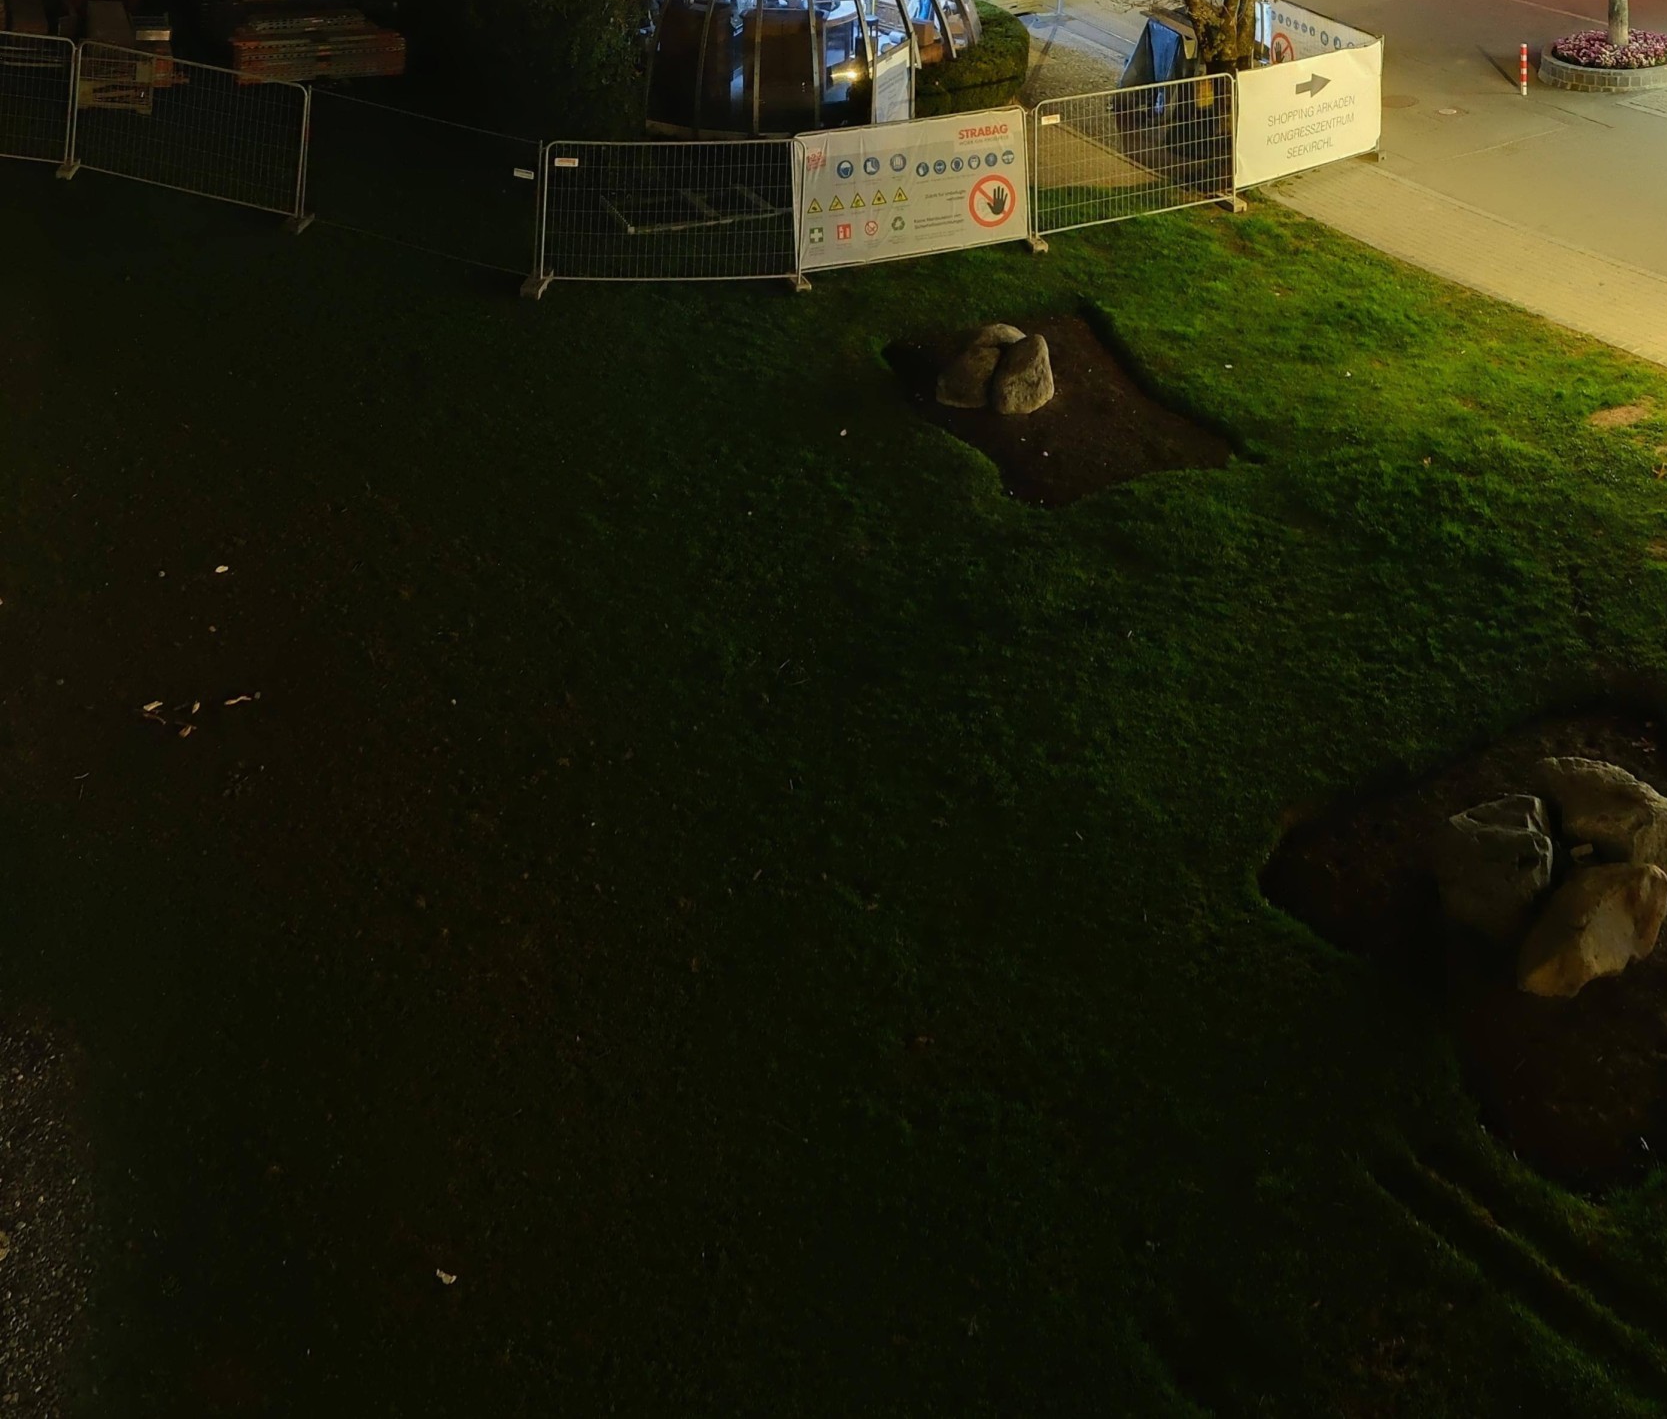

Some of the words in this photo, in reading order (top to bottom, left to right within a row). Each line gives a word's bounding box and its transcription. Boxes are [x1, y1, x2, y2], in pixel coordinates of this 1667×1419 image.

[1267, 105, 1314, 127] SHOPPING
[1316, 95, 1355, 115] ARKADEN
[959, 124, 1008, 139] STRABAG
[1266, 112, 1355, 145] KONGRESSZENTRUM
[1286, 137, 1334, 159] SEEKIRCHL
